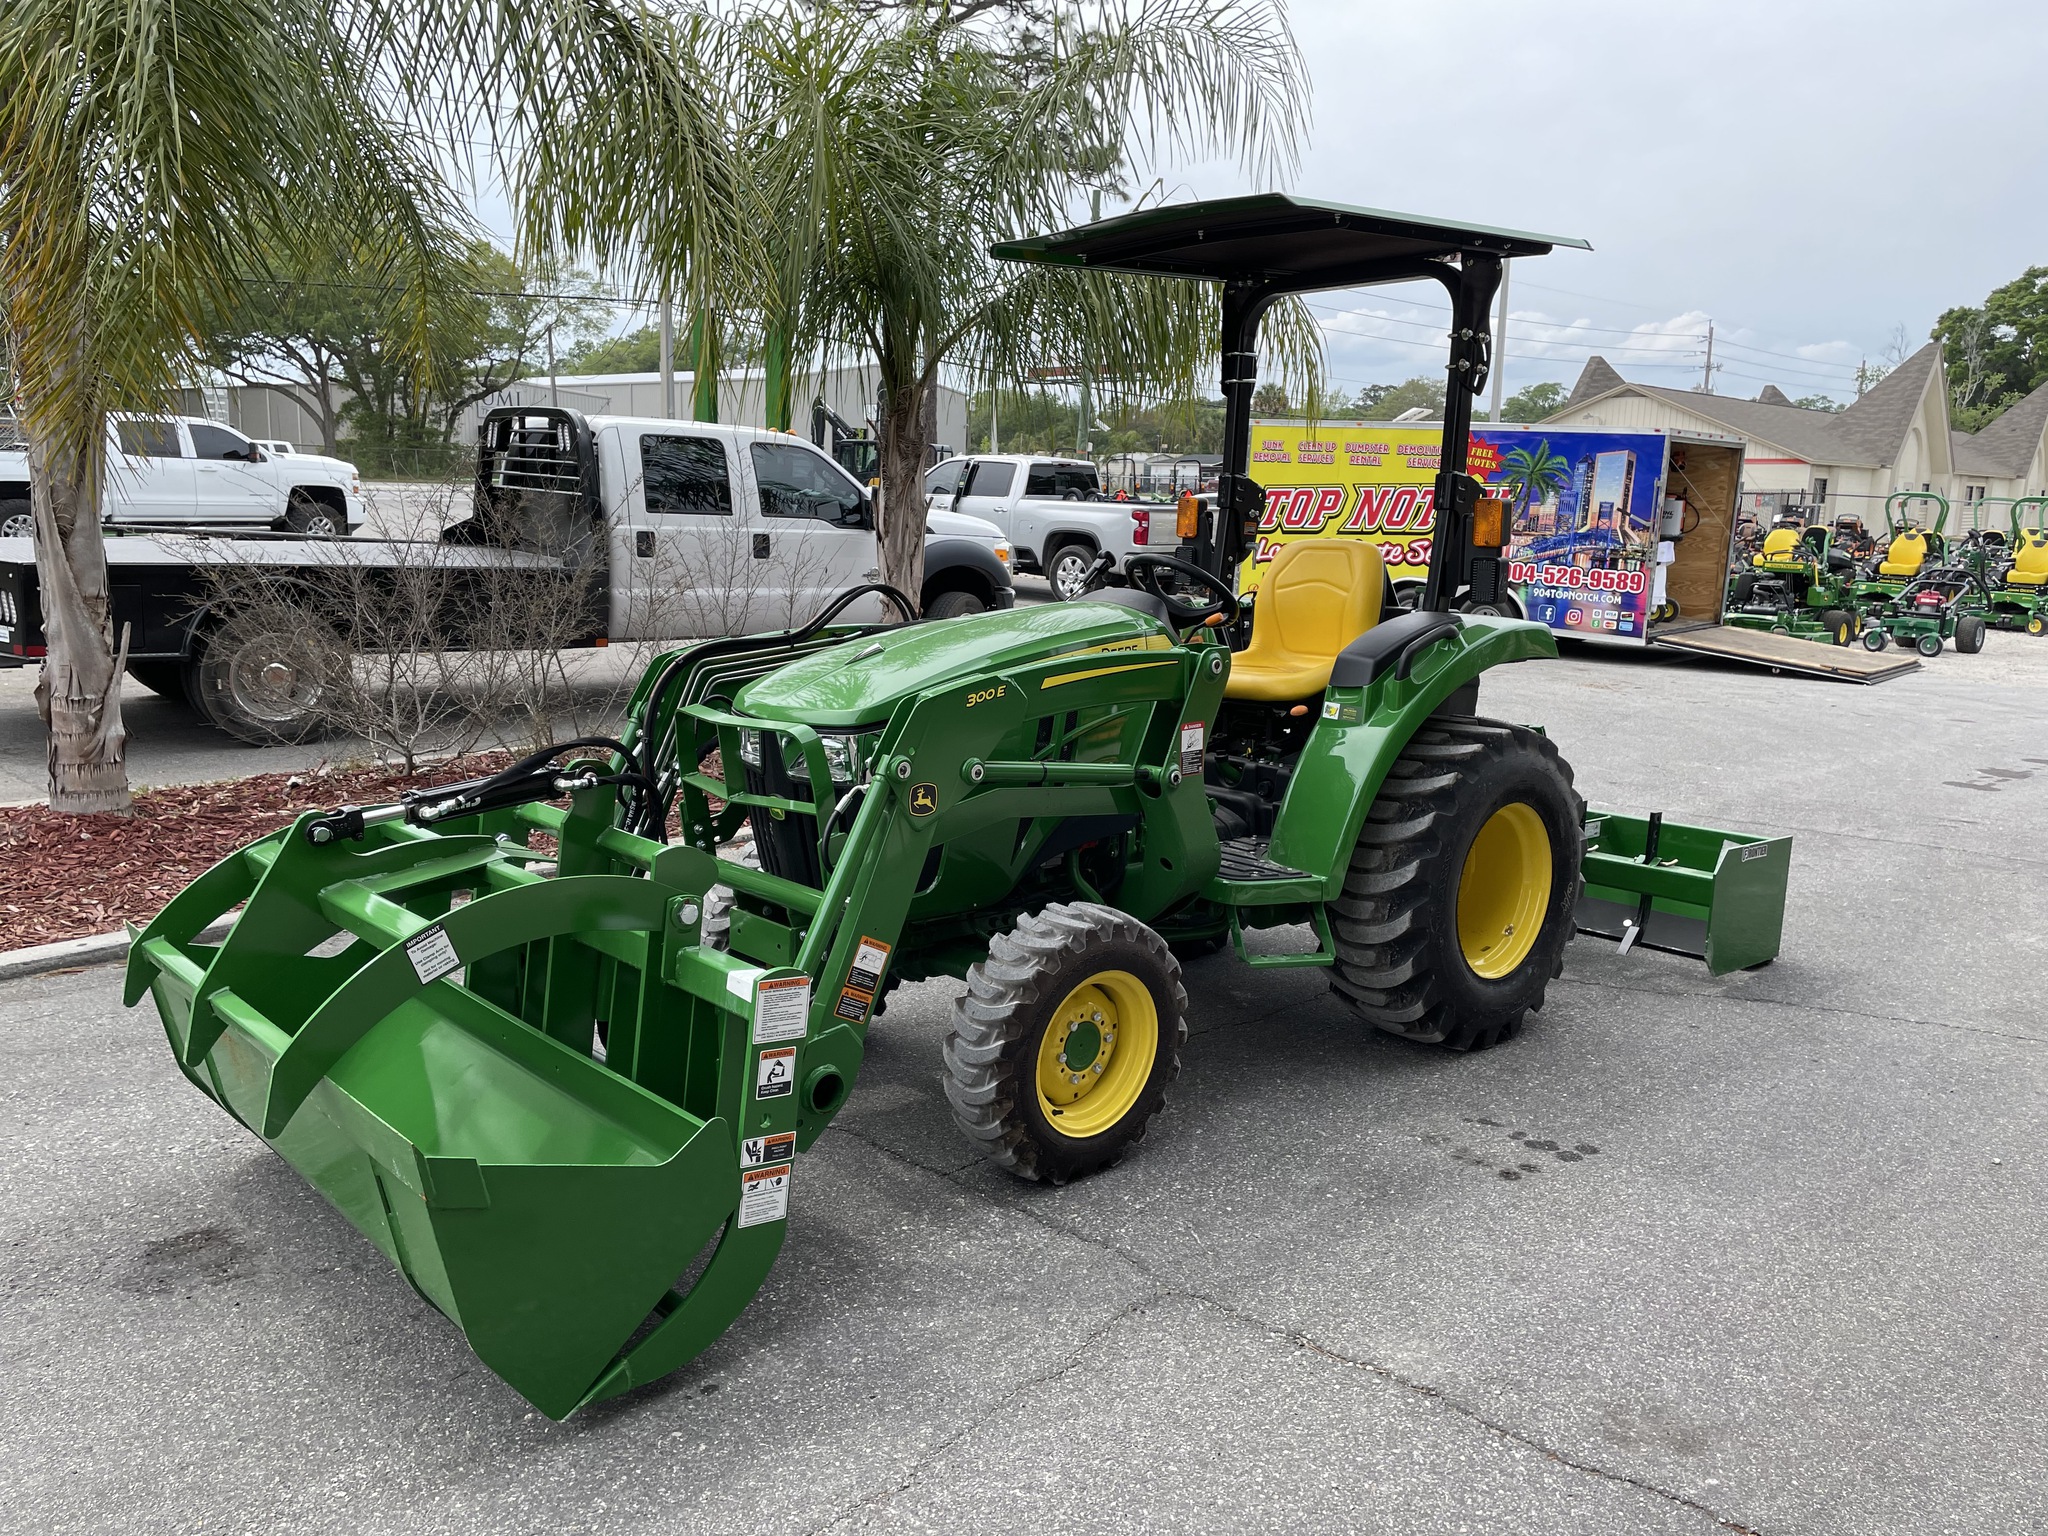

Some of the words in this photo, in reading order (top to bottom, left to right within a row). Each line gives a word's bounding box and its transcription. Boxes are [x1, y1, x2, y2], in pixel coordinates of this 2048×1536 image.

[1262, 440, 1284, 451] JUNK
[1298, 441, 1323, 452] CLEAN
[1325, 441, 1337, 452] UP
[1344, 442, 1390, 454] DUMPSTER
[1397, 444, 1442, 456] DEMOLITI
[1253, 452, 1291, 463] REMOVAL
[1298, 453, 1335, 464] SERVICES
[1471, 448, 1494, 458] FREE
[1349, 455, 1382, 466] RENTAL
[1406, 457, 1440, 469] SERVICE
[1467, 457, 1497, 469] UOTES
[1258, 485, 1347, 532] TOP
[406, 924, 441, 948] IMPORTANT
[773, 980, 801, 988] WARNING
[767, 1050, 793, 1058] WARNING
[770, 1135, 792, 1143] WARNING
[753, 1167, 786, 1179] WARNING
